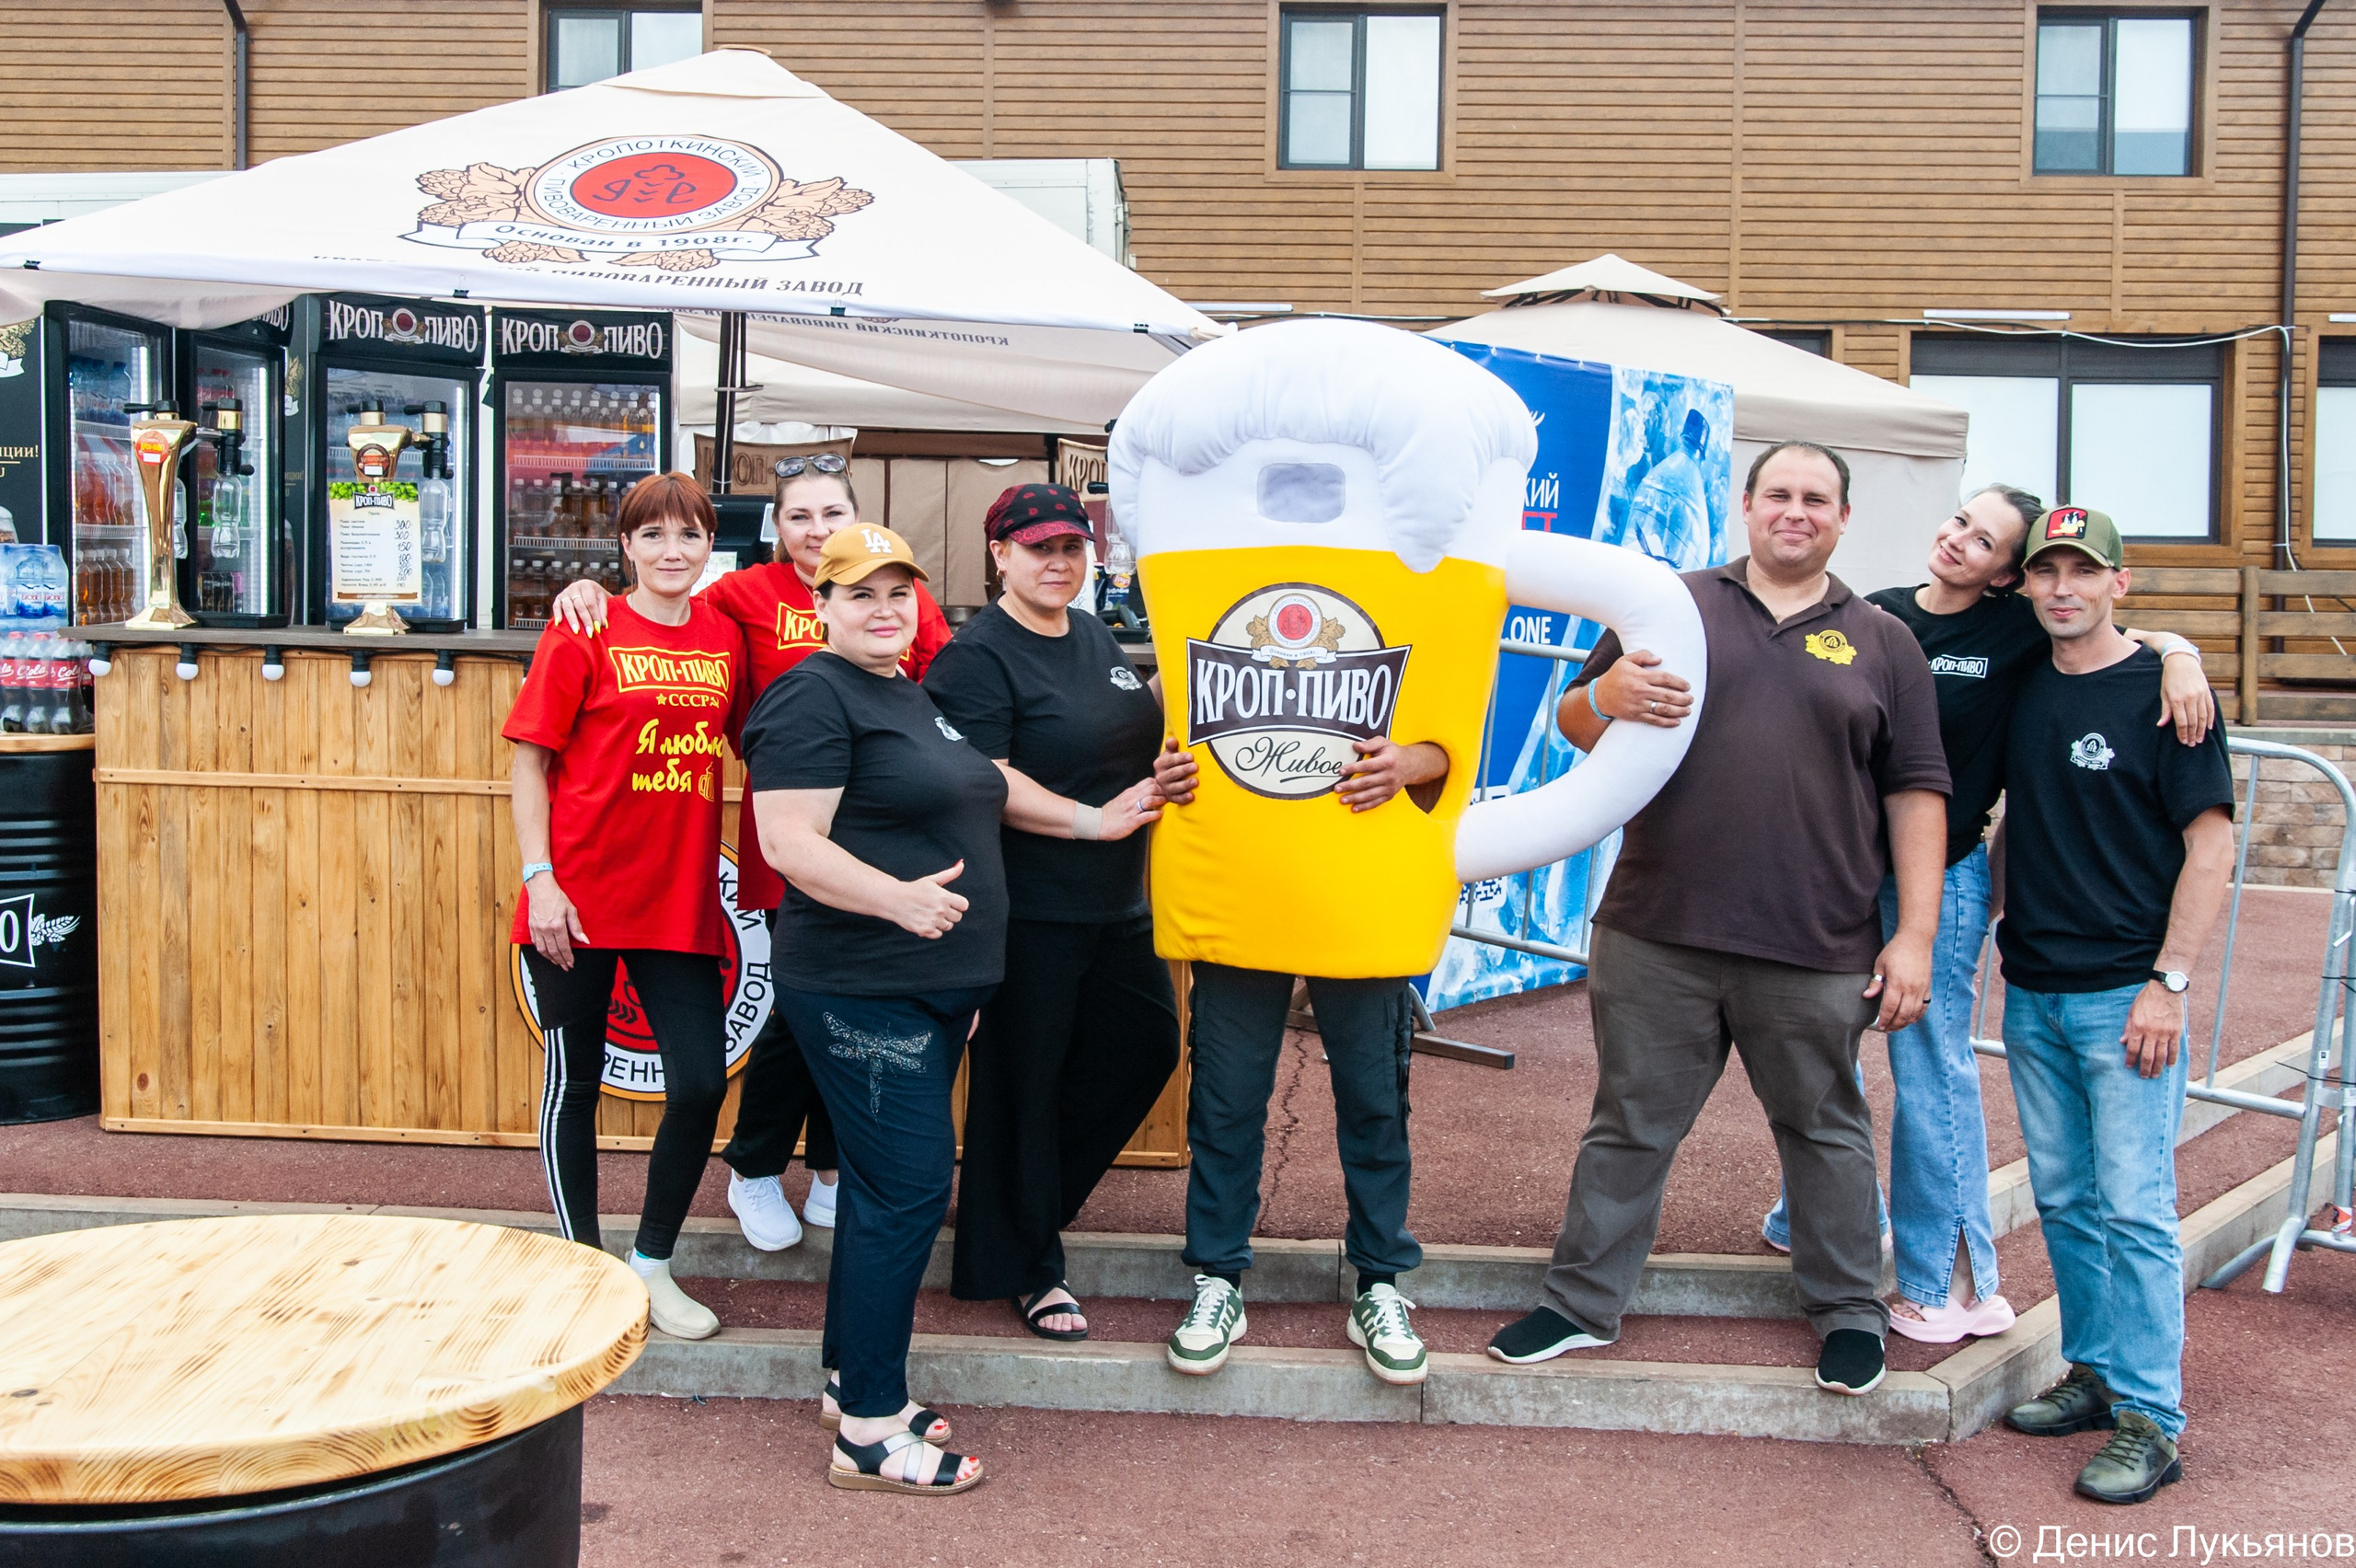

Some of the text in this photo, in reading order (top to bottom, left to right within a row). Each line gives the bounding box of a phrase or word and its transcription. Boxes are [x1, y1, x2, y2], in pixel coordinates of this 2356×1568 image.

[569, 139, 763, 179] КРОПОТКИНСКИЙ
[543, 178, 693, 230] ПИВОВАРЕННЫЙ
[697, 186, 765, 221] ЗАВОД
[495, 225, 614, 248] Основан
[658, 236, 753, 247] 1908г.
[776, 280, 863, 296] ЗАВОД
[329, 299, 478, 353] КРОП ПИВО
[502, 317, 664, 360] КРОП ПИВО
[860, 528, 893, 554] LA
[668, 693, 709, 707] СССР
[635, 718, 659, 755] Я
[632, 757, 692, 792] тебя
[1235, 736, 1343, 778] Живое
